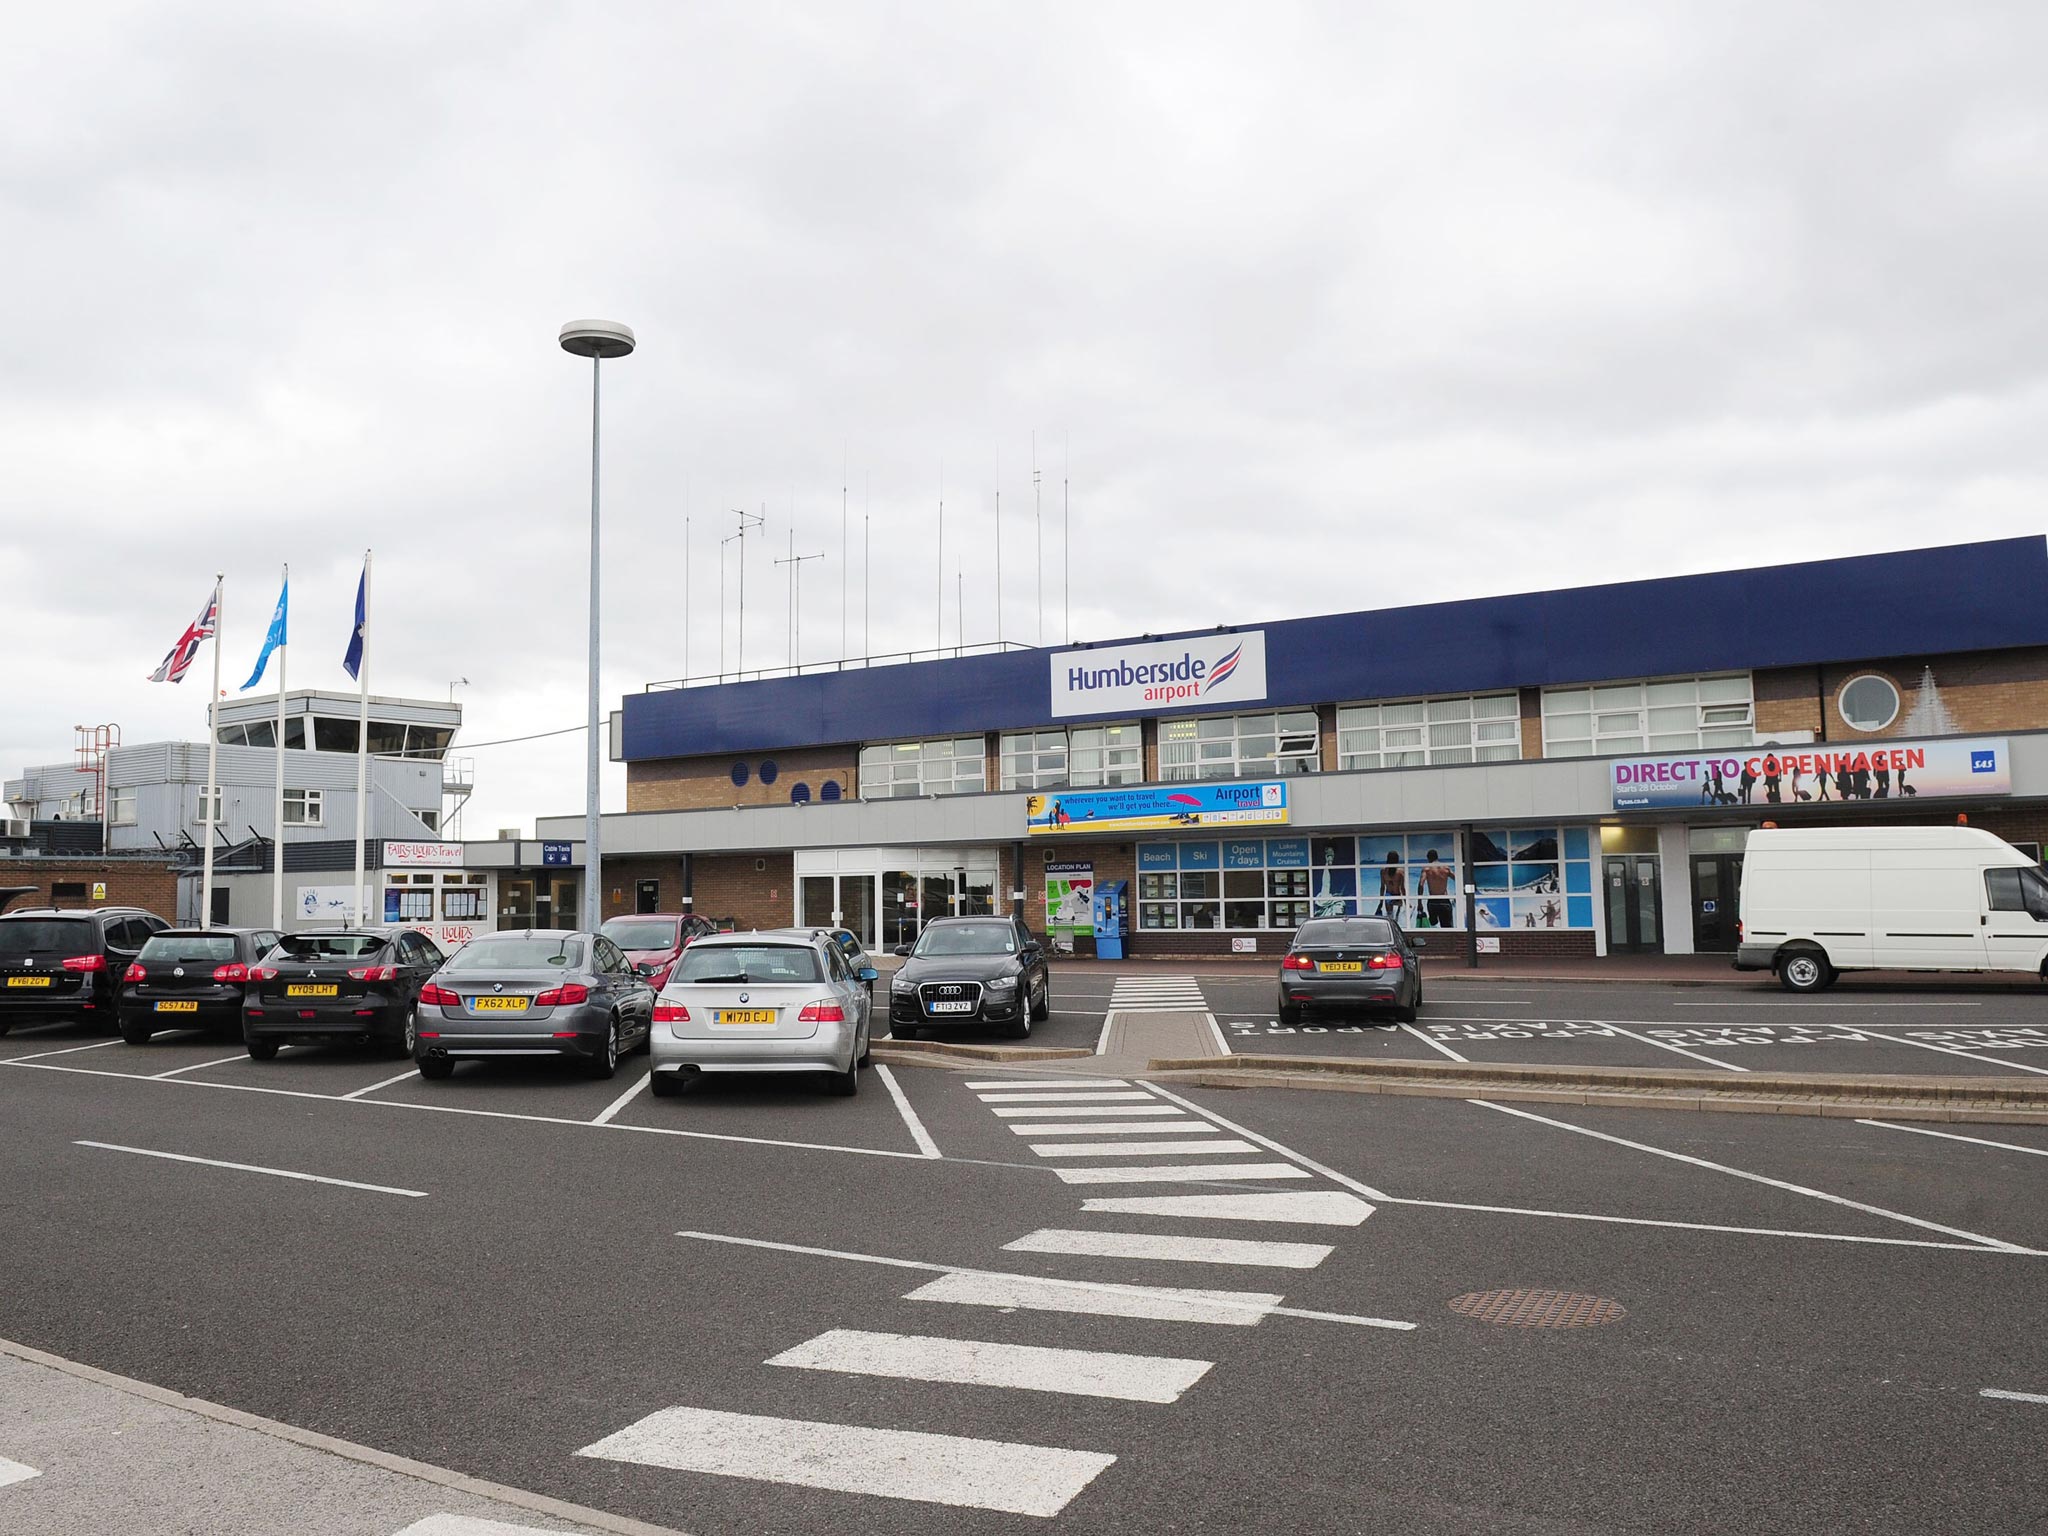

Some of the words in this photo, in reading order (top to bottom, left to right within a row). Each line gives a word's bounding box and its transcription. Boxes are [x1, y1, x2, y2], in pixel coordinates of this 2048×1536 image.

[1068, 653, 1206, 691] Humberside
[1144, 681, 1200, 703] airport
[1616, 761, 1700, 784] DIRECT
[1706, 758, 1740, 780] TO
[1746, 748, 1925, 778] COPENHAGEN
[1973, 760, 1993, 769] SAS
[1616, 784, 1637, 793] Starts
[1638, 783, 1649, 792] 28
[1650, 782, 1679, 792] October
[1064, 795, 1095, 804] wherever
[1096, 796, 1108, 804] you
[1109, 794, 1127, 802] want
[1136, 792, 1156, 800] travel
[1215, 786, 1260, 803] Airport
[1107, 802, 1124, 810] we'll
[1125, 803, 1137, 812] get
[1138, 802, 1151, 811] you
[1237, 798, 1260, 808] travel
[439, 845, 462, 857] Travel
[1231, 845, 1257, 855] Open
[1143, 853, 1171, 862] Beach
[1193, 851, 1208, 860] Ski
[1230, 856, 1235, 864] 7
[1237, 856, 1259, 866] days
[292, 985, 314, 993] YY09
[316, 985, 333, 993] LHT
[160, 1002, 179, 1010] SC57
[180, 1002, 195, 1010] AZB
[476, 998, 503, 1008] FX62
[505, 998, 526, 1008] XLP
[954, 1002, 968, 1010] ZVZ
[753, 1012, 768, 1022] CJ
[1426, 1022, 1593, 1032] TAXIS
[1646, 1026, 1823, 1037] TAXIS
